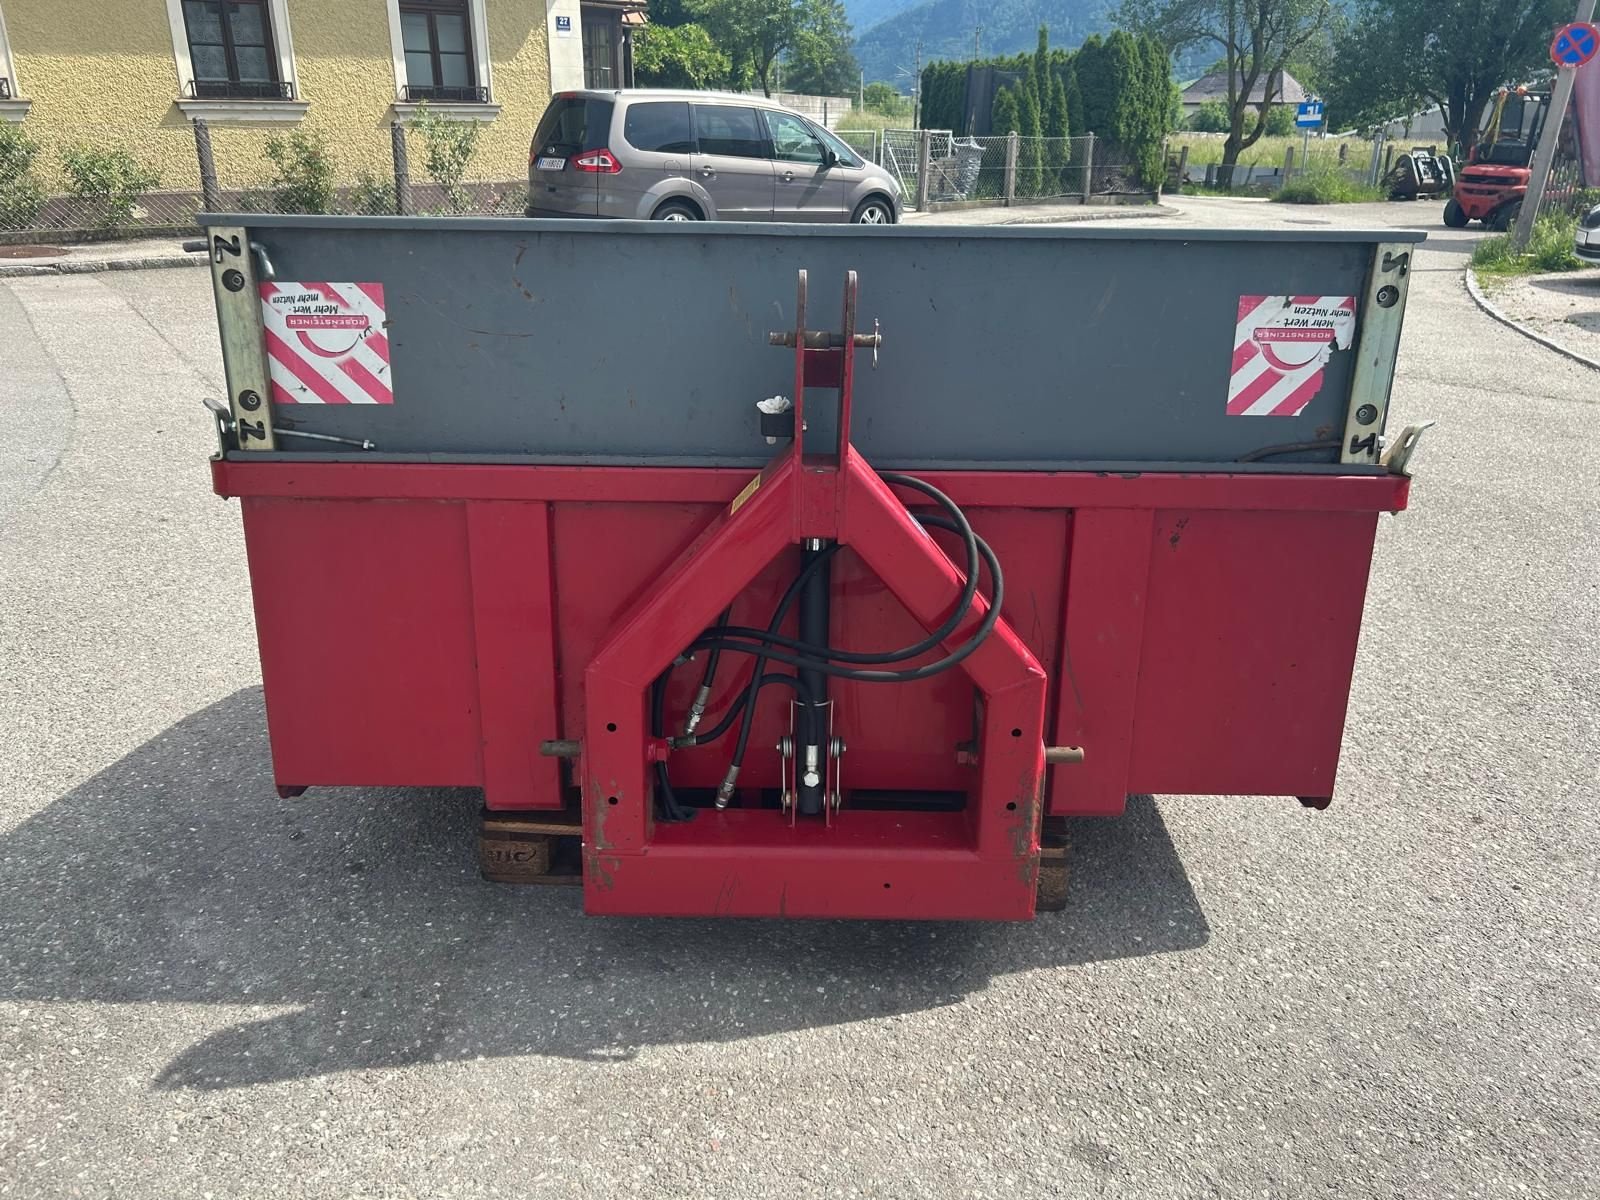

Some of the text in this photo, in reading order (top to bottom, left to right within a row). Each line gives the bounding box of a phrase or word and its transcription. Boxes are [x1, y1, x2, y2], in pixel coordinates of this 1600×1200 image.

[559, 17, 568, 25] 27
[272, 293, 319, 304] mehr Nutzen
[293, 306, 312, 314] Wert
[313, 305, 339, 314] Mehr
[1294, 306, 1351, 317] mehr Nutzen
[1284, 318, 1309, 328] Wert
[1311, 319, 1335, 328] Mehr
